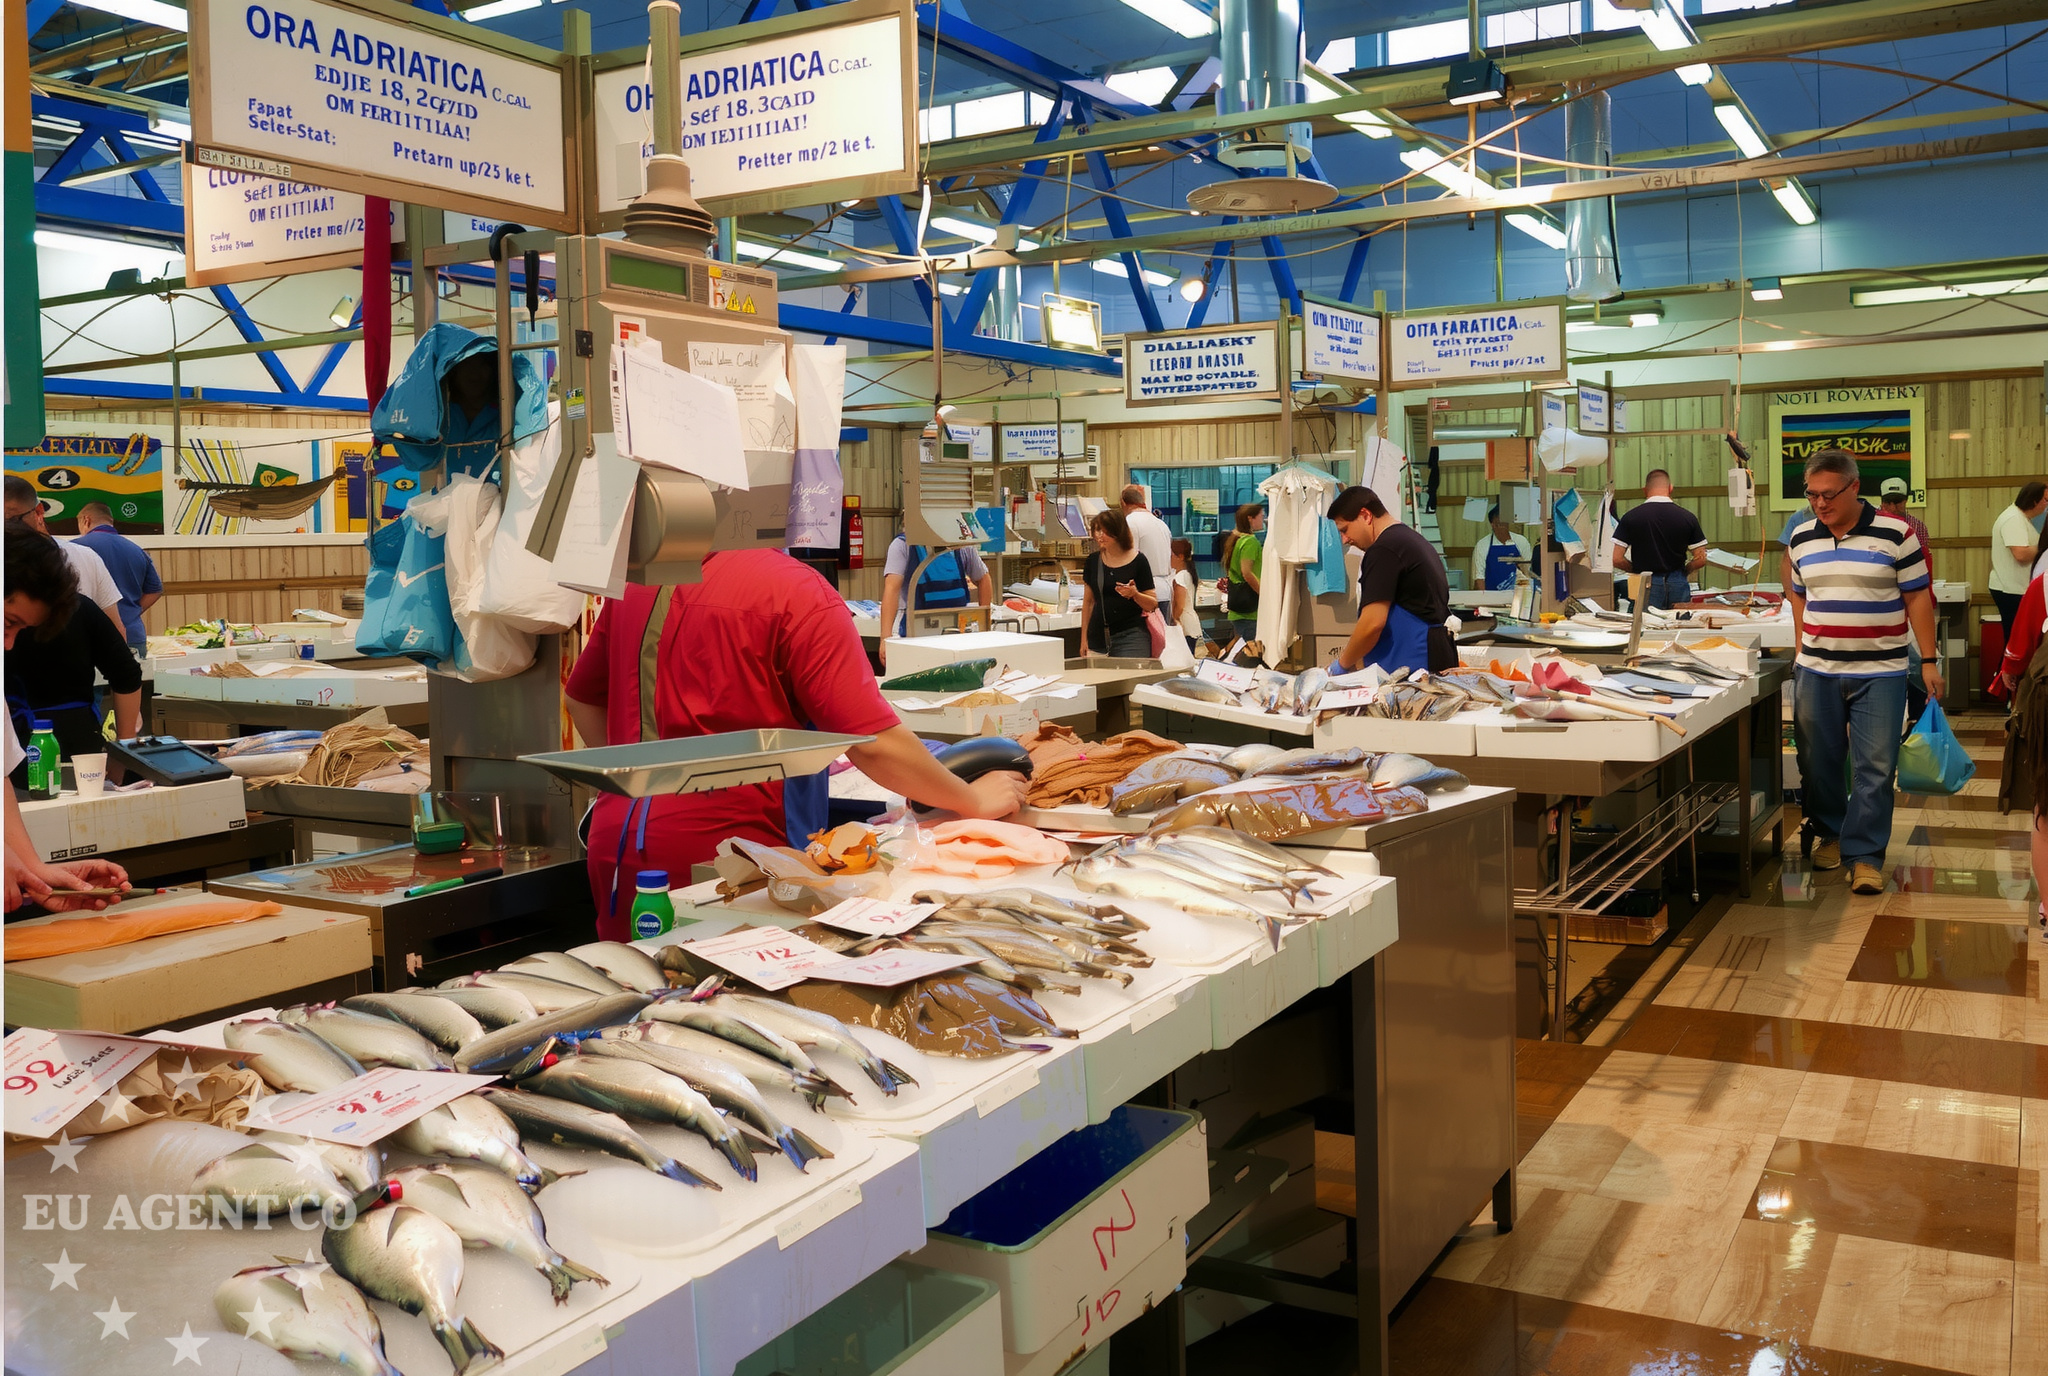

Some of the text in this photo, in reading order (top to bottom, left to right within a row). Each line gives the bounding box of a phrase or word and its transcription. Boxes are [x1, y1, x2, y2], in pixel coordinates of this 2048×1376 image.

[246, 4, 320, 54] ORA
[331, 28, 487, 99] ADRIATICA
[687, 50, 825, 102] ADRIATICA
[326, 93, 354, 115] OM
[48, 470, 72, 488] 4
